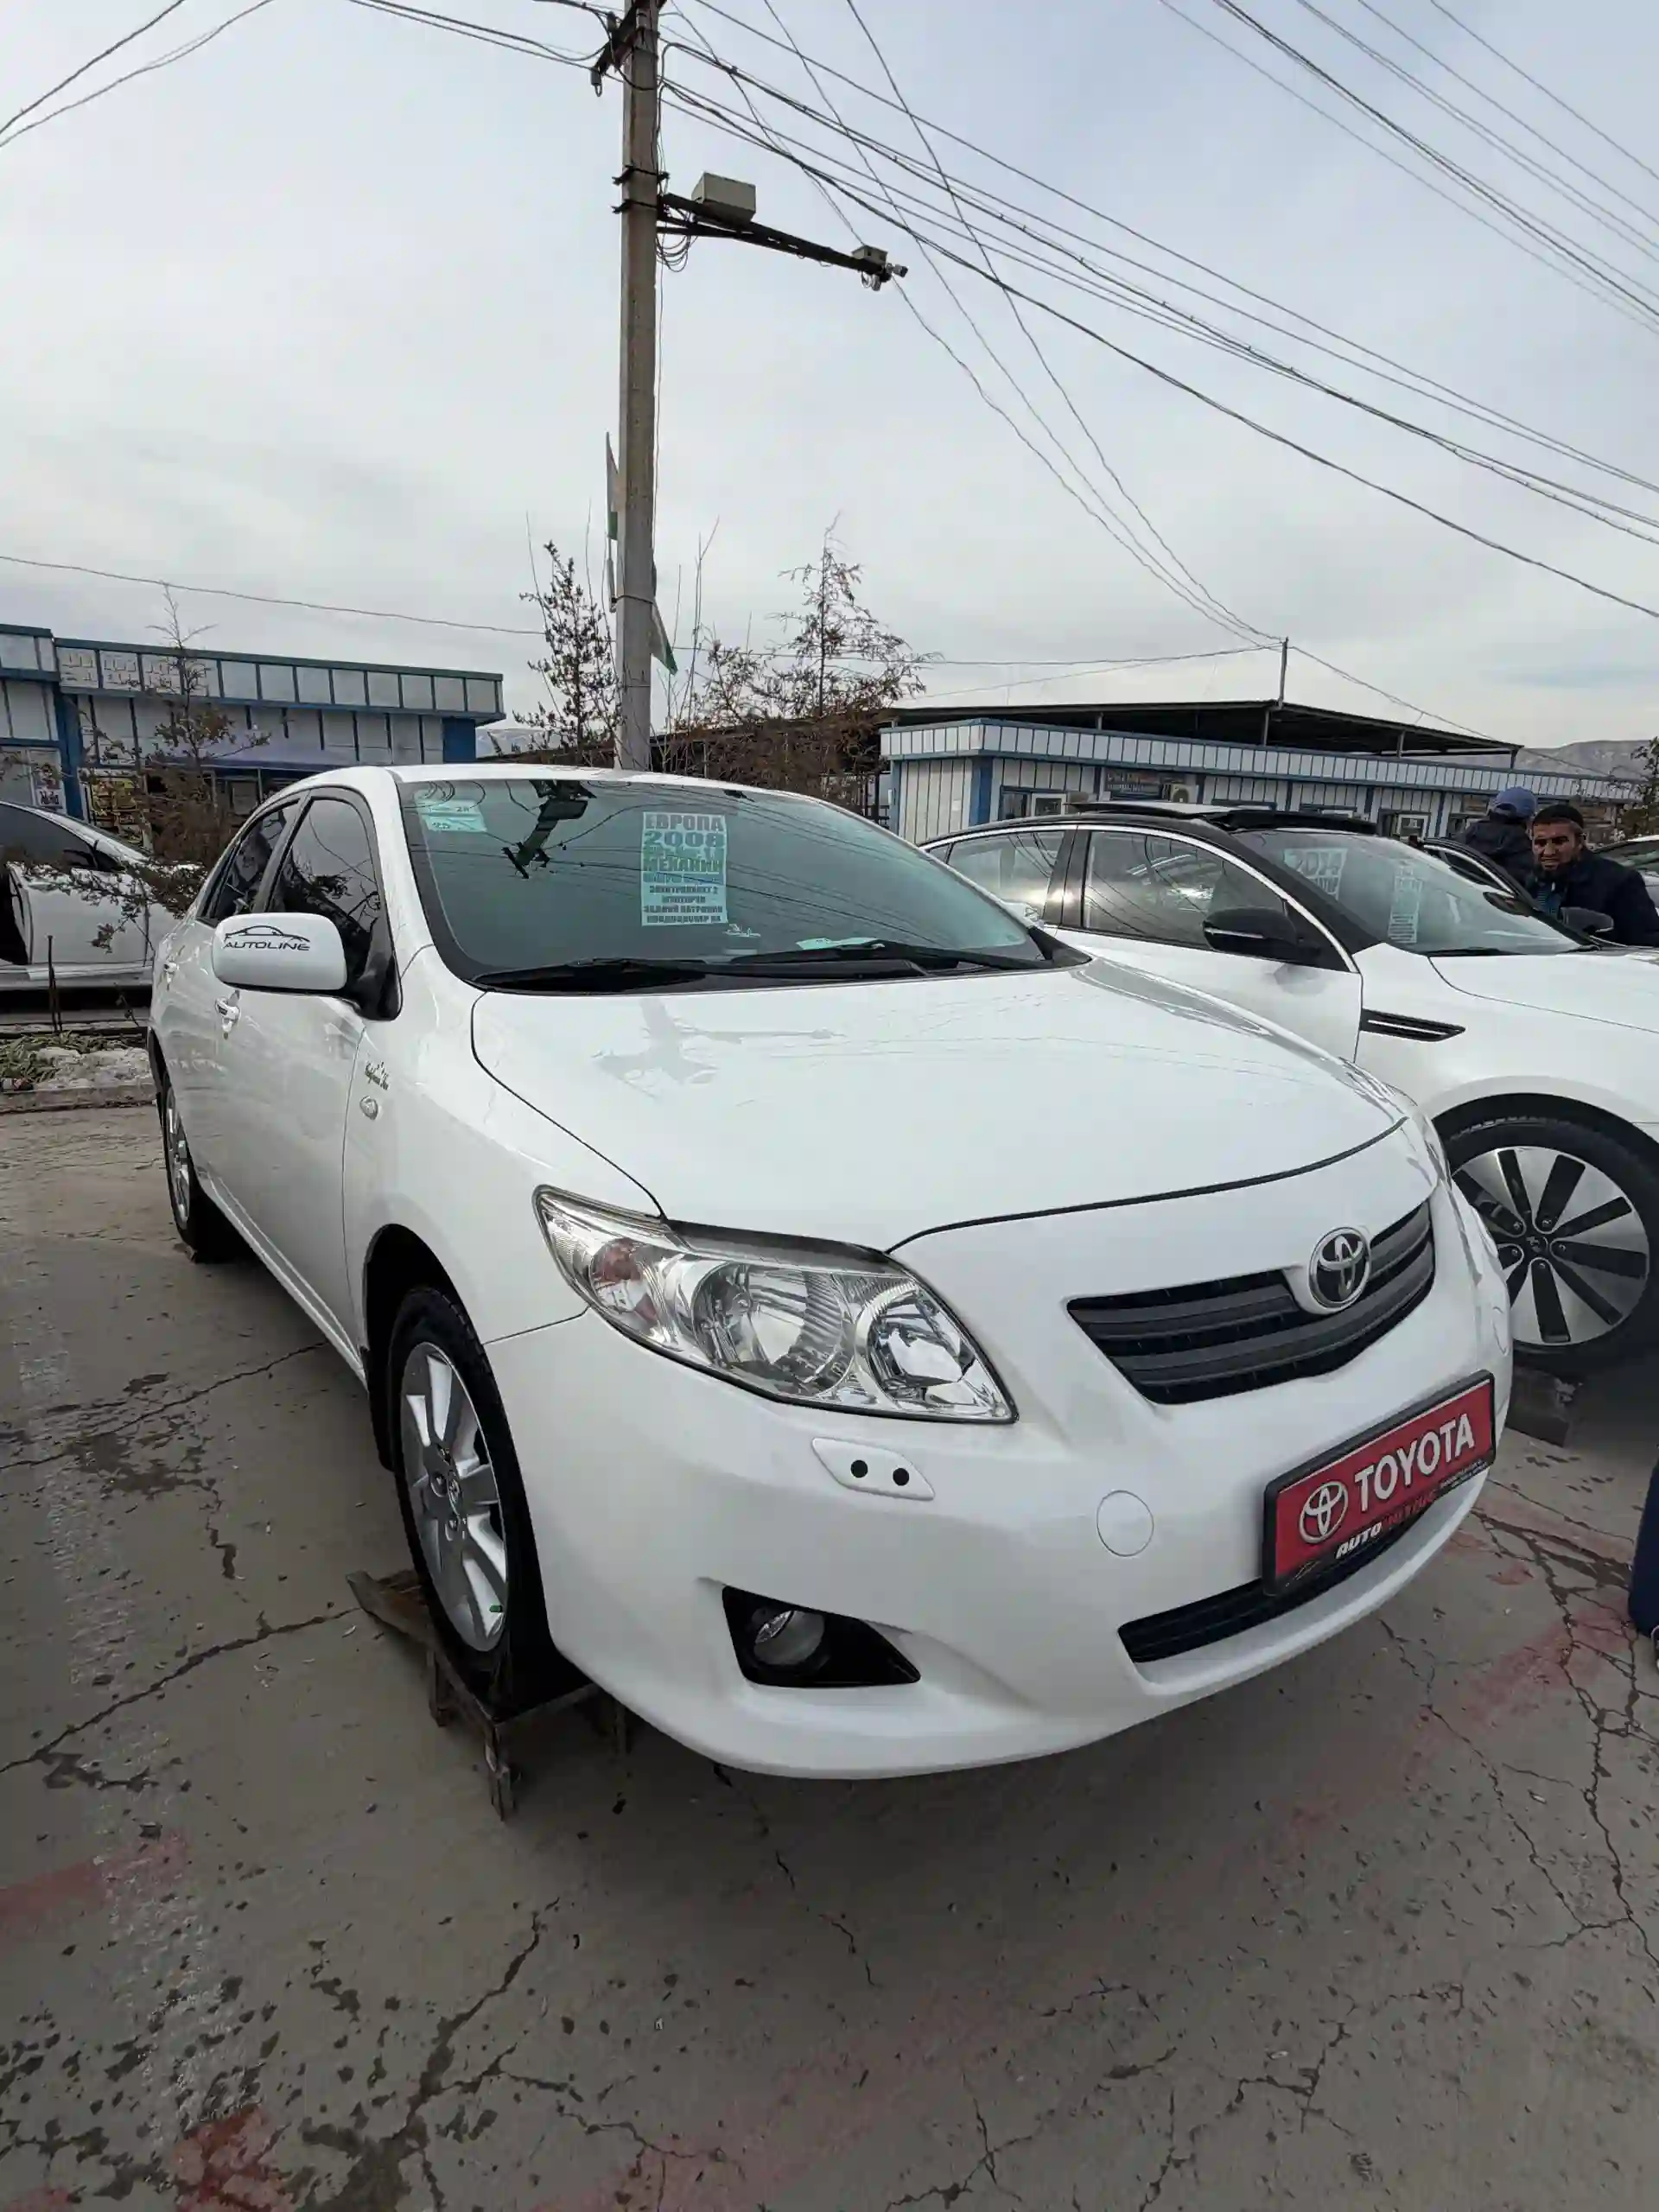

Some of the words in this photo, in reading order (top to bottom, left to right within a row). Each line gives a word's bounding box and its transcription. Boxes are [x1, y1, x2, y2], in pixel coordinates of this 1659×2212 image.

[645, 815, 724, 831] ЕВРОПА
[644, 830, 724, 848] 2008
[224, 941, 311, 951] AUTOLINE
[1355, 1413, 1475, 1512] TOYOTA
[1336, 1522, 1382, 1559] AUTO
